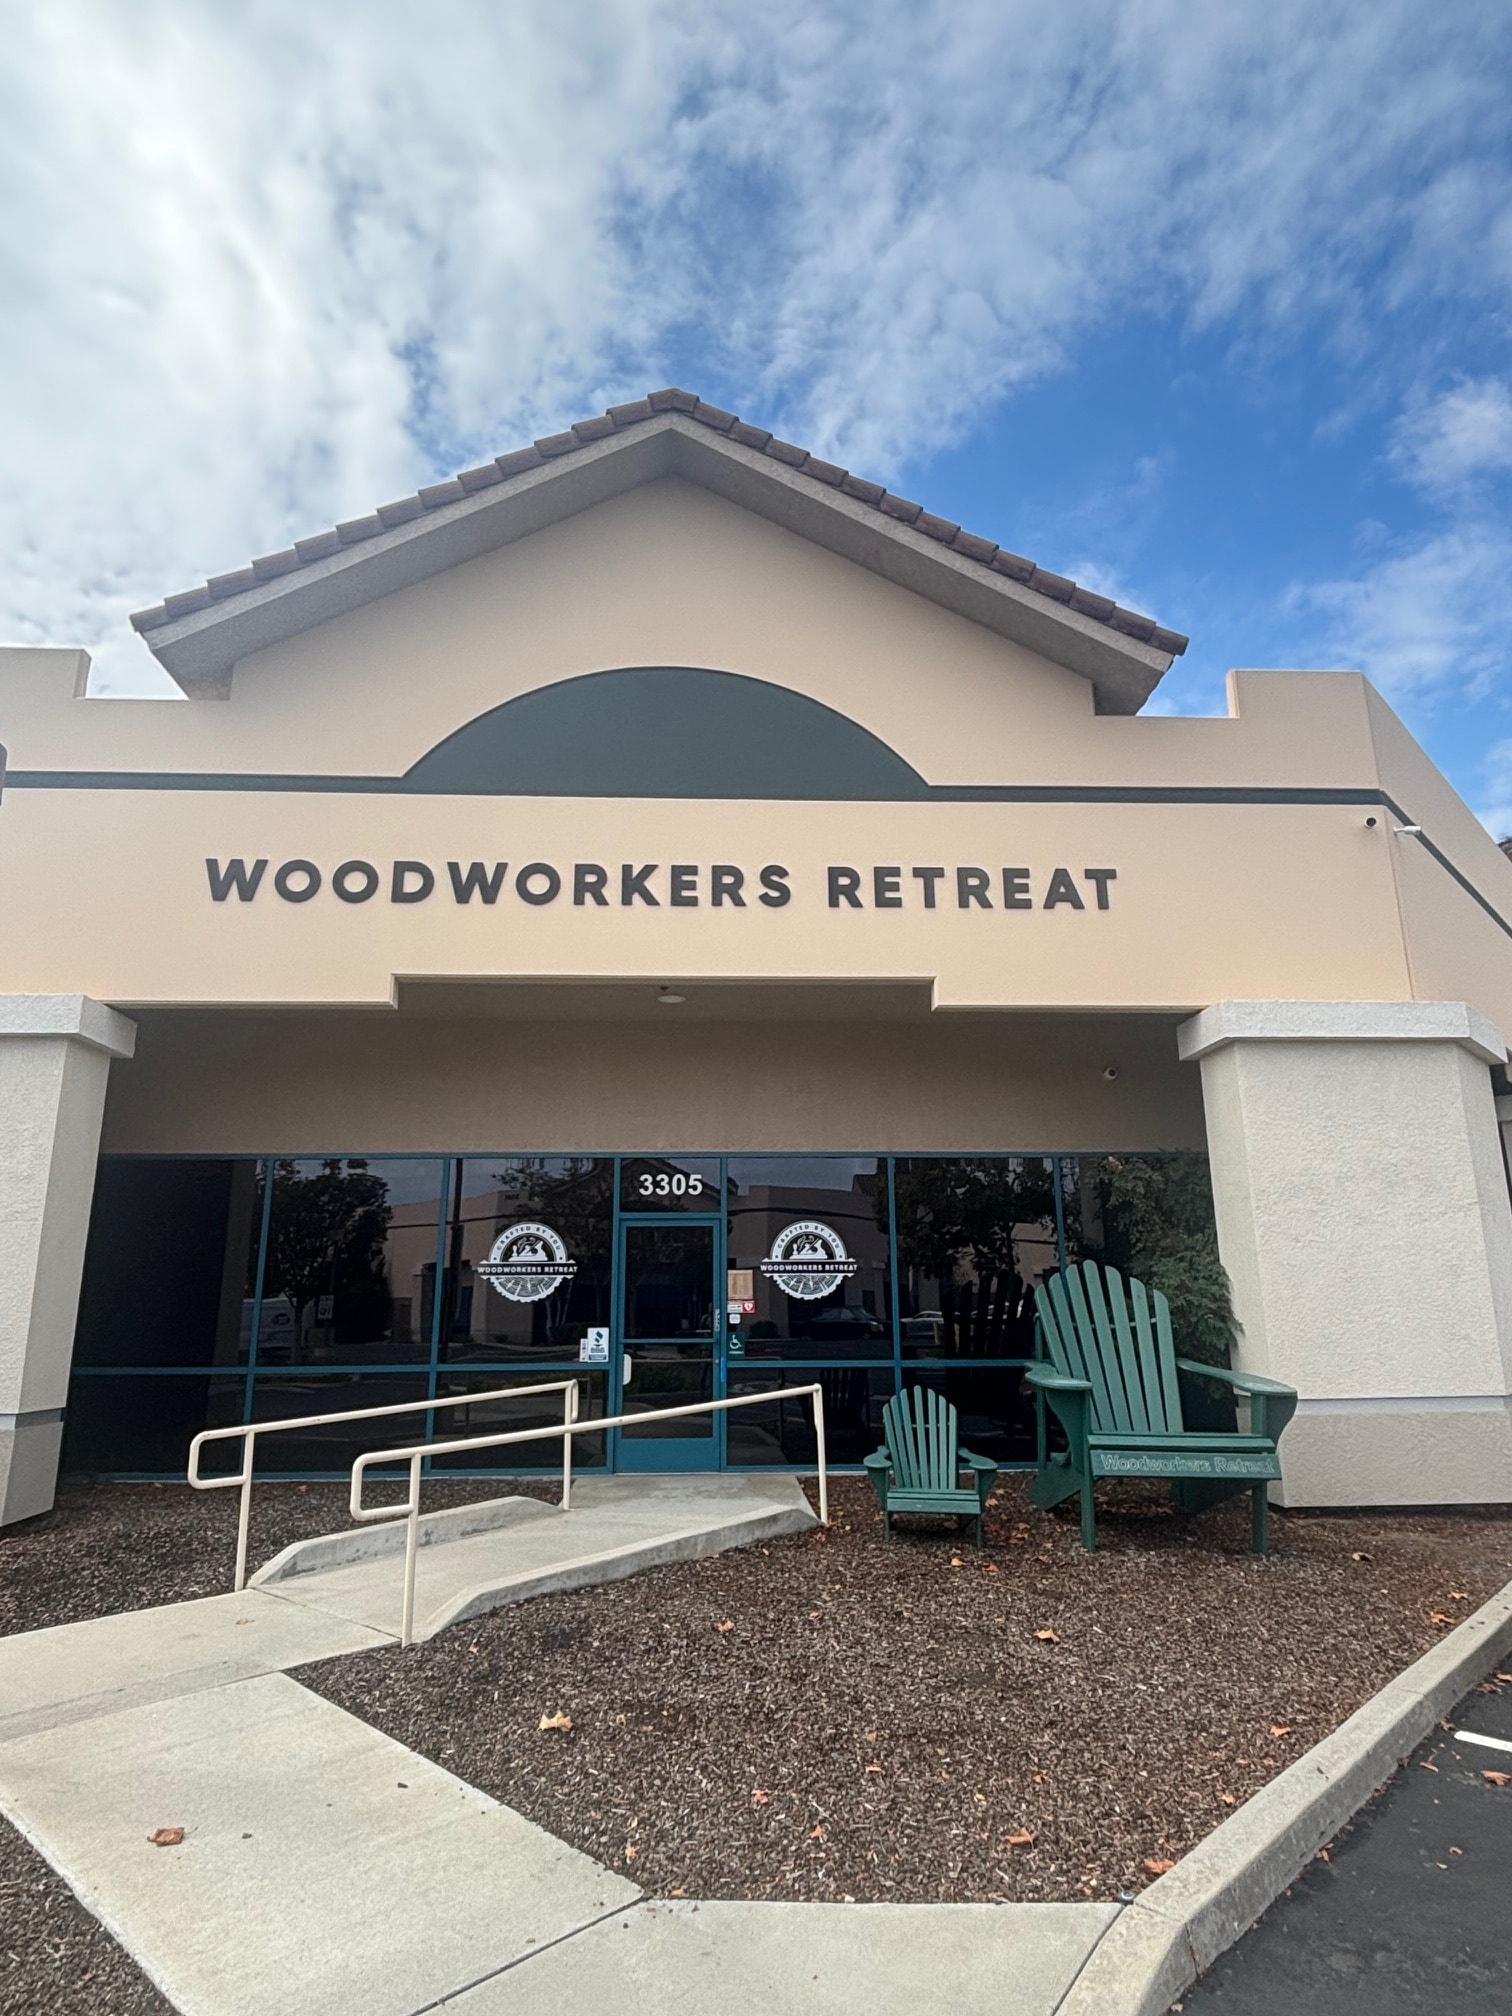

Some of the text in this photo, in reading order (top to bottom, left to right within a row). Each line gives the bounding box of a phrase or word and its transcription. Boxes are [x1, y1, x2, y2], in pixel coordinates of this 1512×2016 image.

[205, 857, 1118, 910] WOODWORKERS RETREAT
[639, 1173, 703, 1196] 3305
[496, 1225, 561, 1251] CRAFTED BY YOU
[777, 1224, 841, 1249] CRAFTED BY YOU
[1100, 1453, 1276, 1474] Woodworkers Retreat
